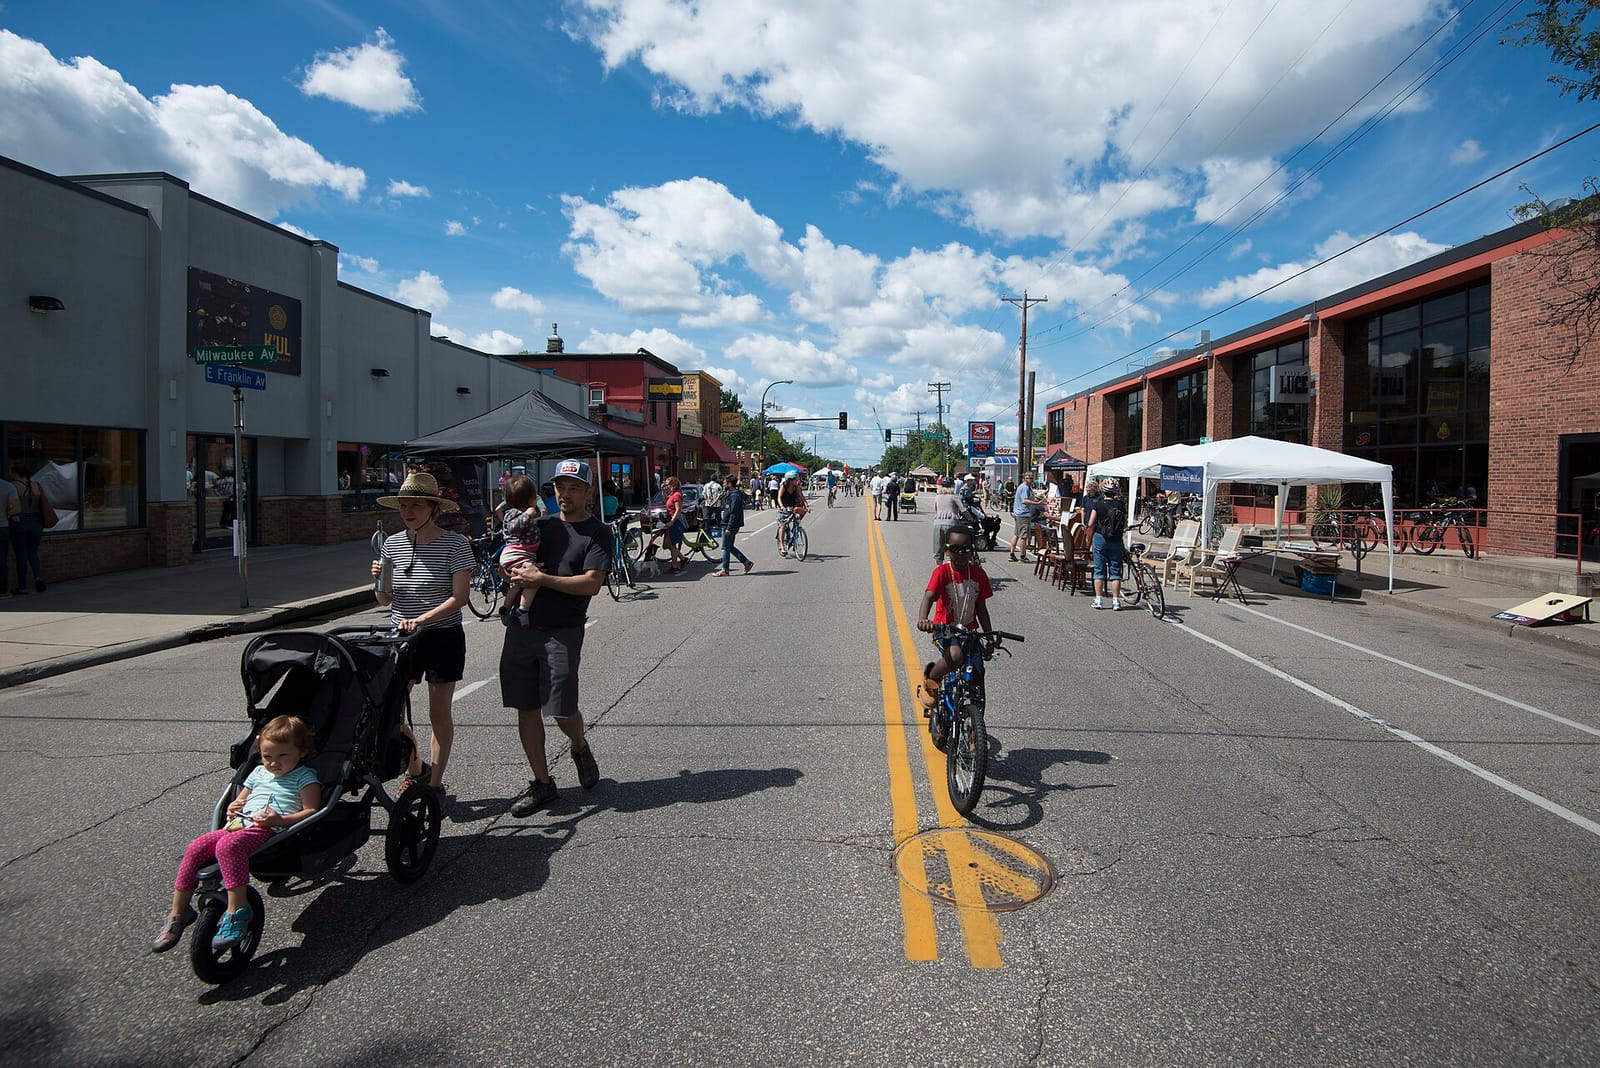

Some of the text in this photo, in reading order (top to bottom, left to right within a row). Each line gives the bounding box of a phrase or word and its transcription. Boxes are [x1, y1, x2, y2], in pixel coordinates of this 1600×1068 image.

[196, 349, 254, 361] Milwaukee
[206, 367, 213, 379] E
[218, 369, 251, 385] Franklin
